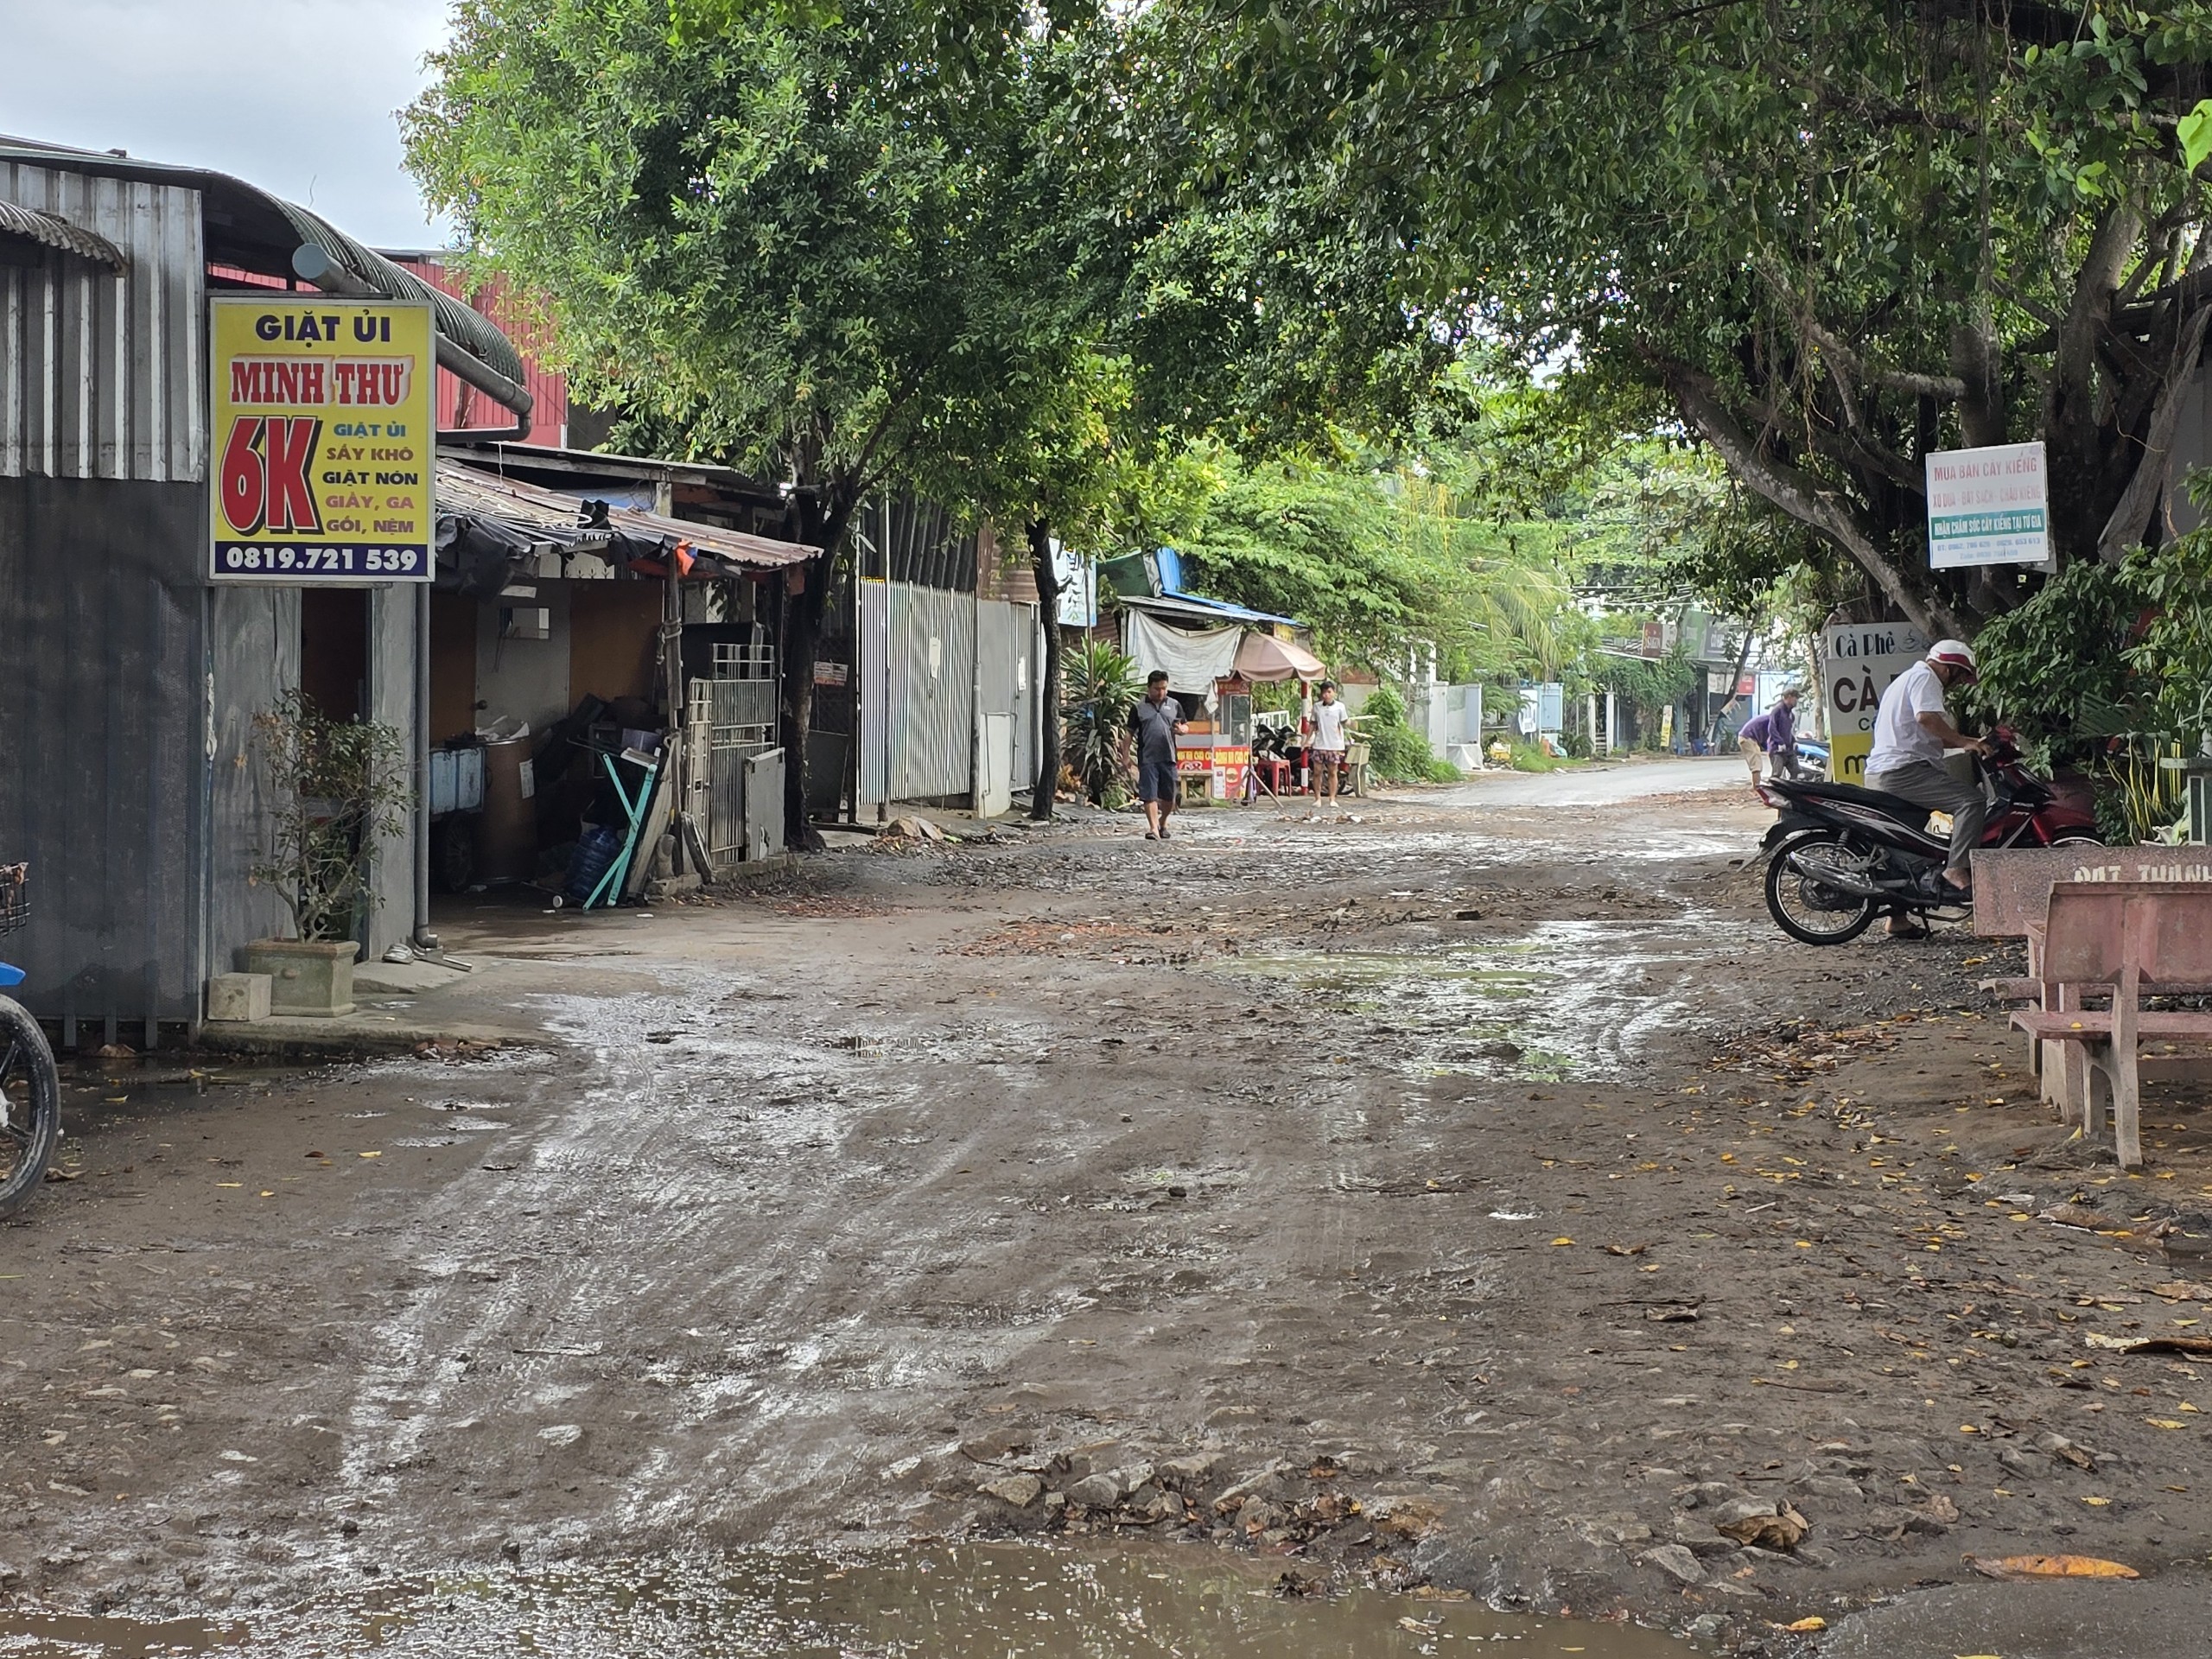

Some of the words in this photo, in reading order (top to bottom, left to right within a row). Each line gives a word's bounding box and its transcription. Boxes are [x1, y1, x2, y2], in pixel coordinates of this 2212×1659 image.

[256, 310, 340, 347] GIẶT
[353, 309, 391, 342] ỦI
[232, 361, 324, 404] MINH
[335, 364, 404, 405] THƯ
[334, 422, 381, 438] GIẶT
[386, 421, 406, 437] ỦI
[327, 443, 365, 461] SẤY
[221, 416, 321, 532] 6K
[322, 469, 371, 486] GIẶT
[1934, 467, 1956, 481] MUA
[386, 497, 415, 509] GA
[327, 515, 367, 535] GỐI,
[373, 518, 414, 535] NỆM
[226, 547, 353, 569] 0819.721
[365, 550, 418, 571] 539
[1836, 633, 1857, 658] Cà
[1863, 631, 1896, 656] Phê
[1834, 664, 1879, 713] CÀ
